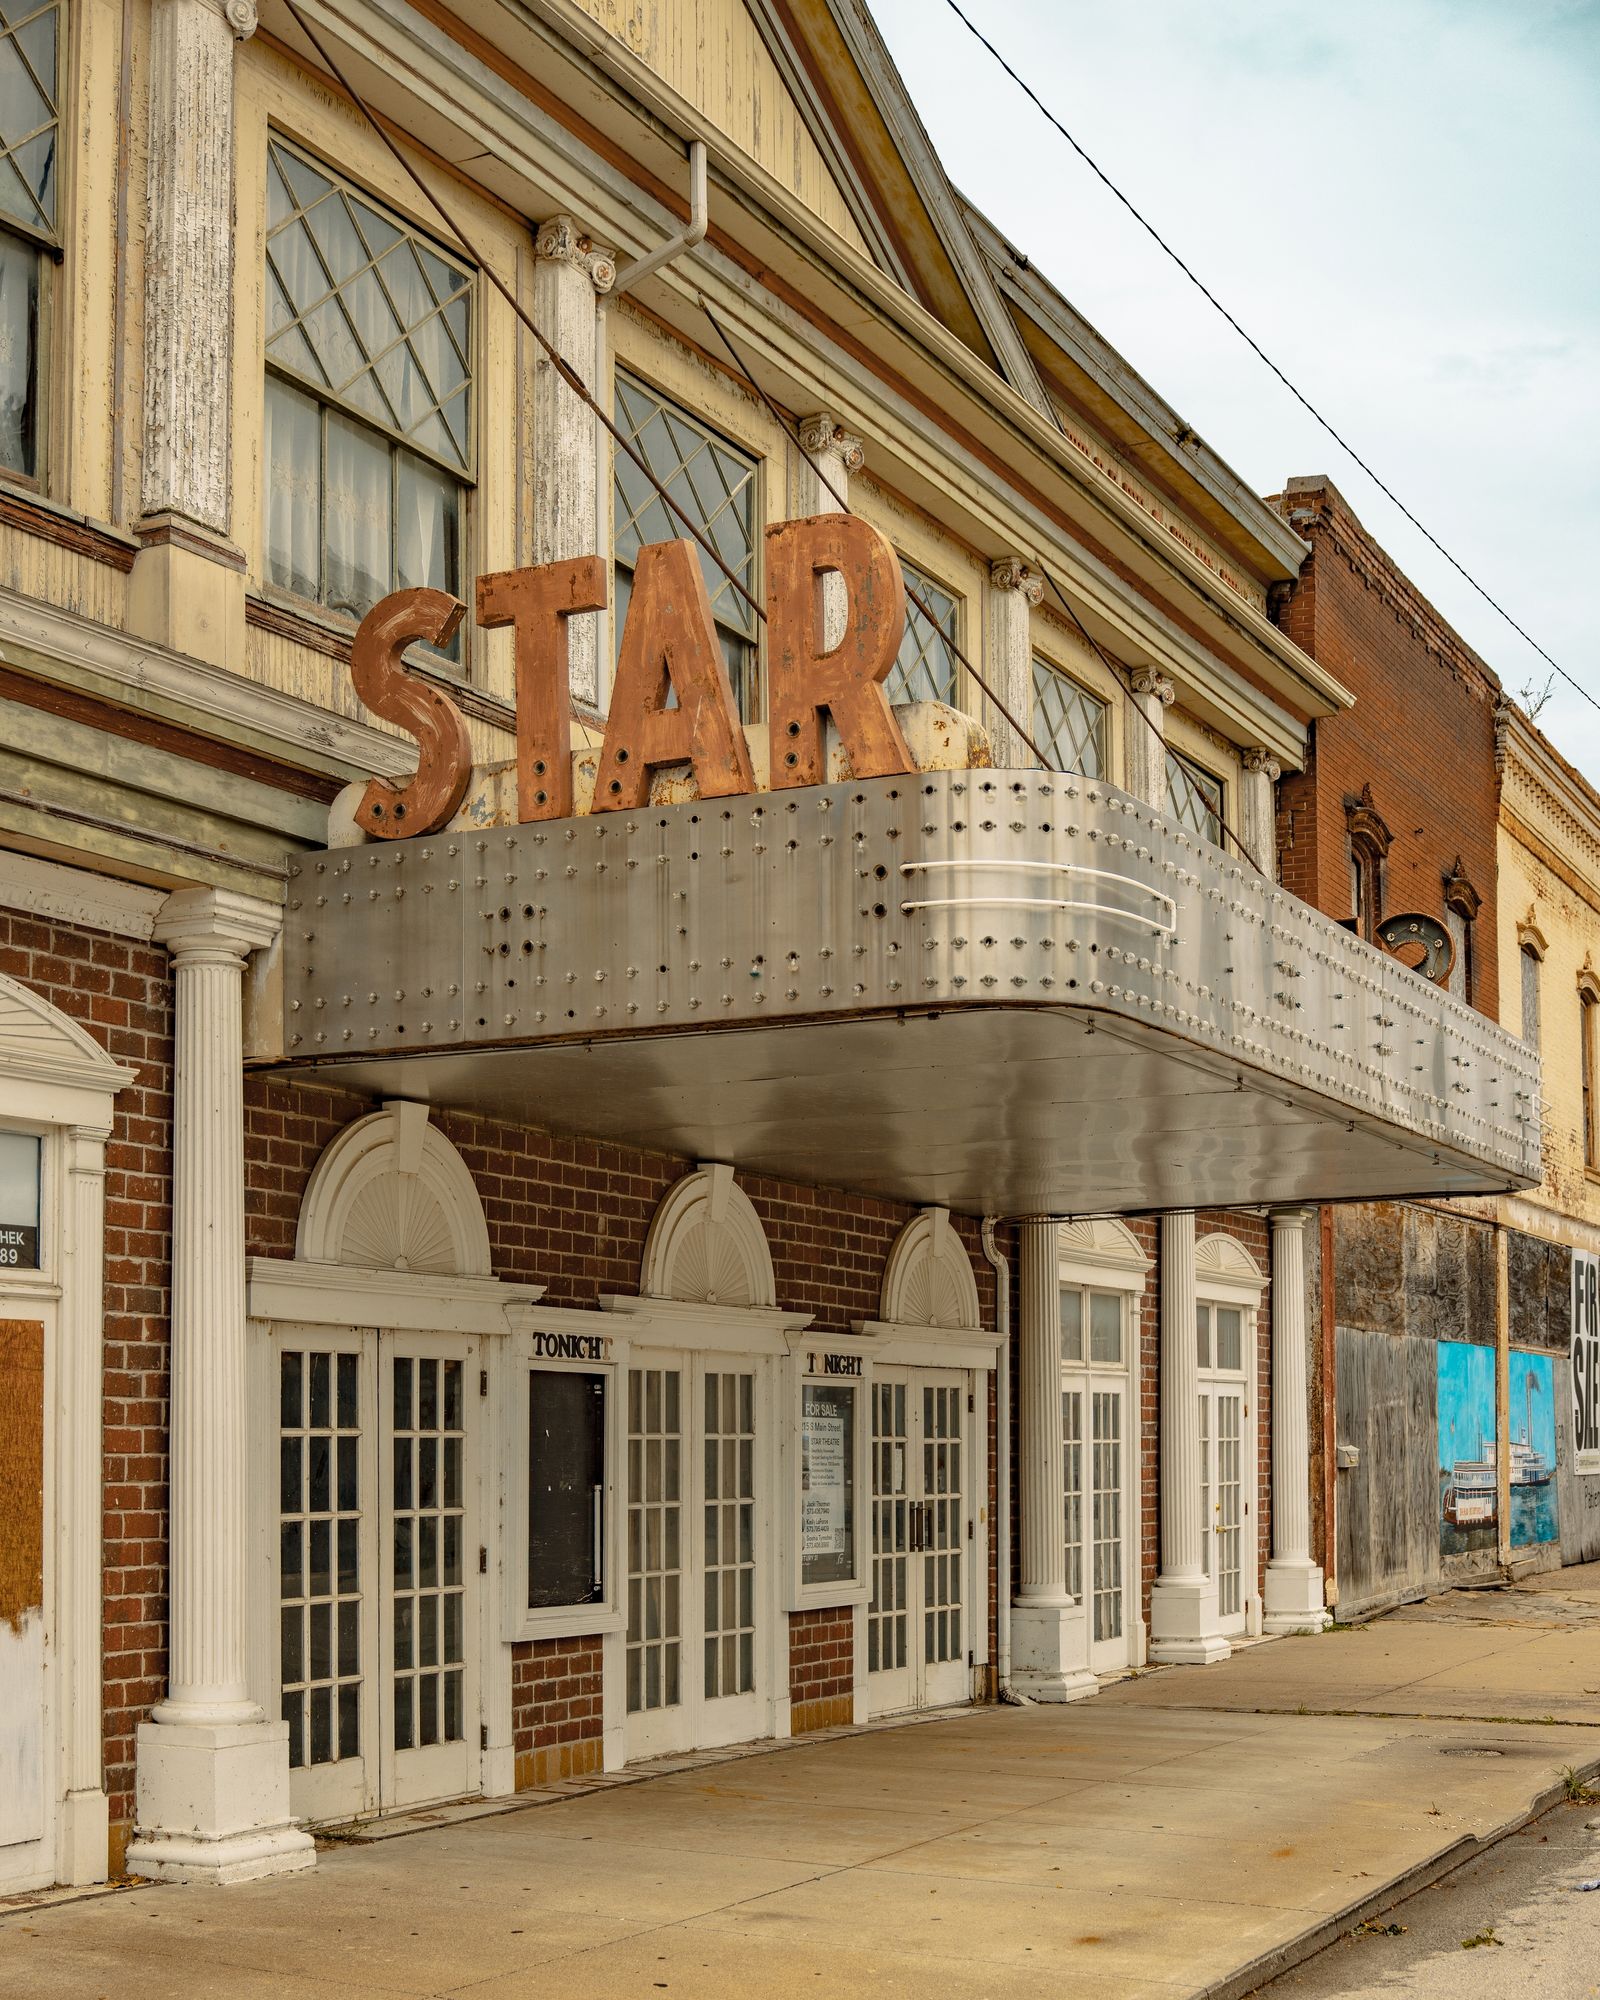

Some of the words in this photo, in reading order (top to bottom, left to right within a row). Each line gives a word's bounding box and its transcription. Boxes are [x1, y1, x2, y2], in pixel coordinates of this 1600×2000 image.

[351, 513, 917, 840] STAR
[532, 1331, 613, 1360] TONIGHT
[805, 1403, 820, 1416] FOR
[821, 1403, 838, 1417] SALE
[814, 1422, 827, 1432] Main
[822, 1438, 840, 1446] THEATRE
